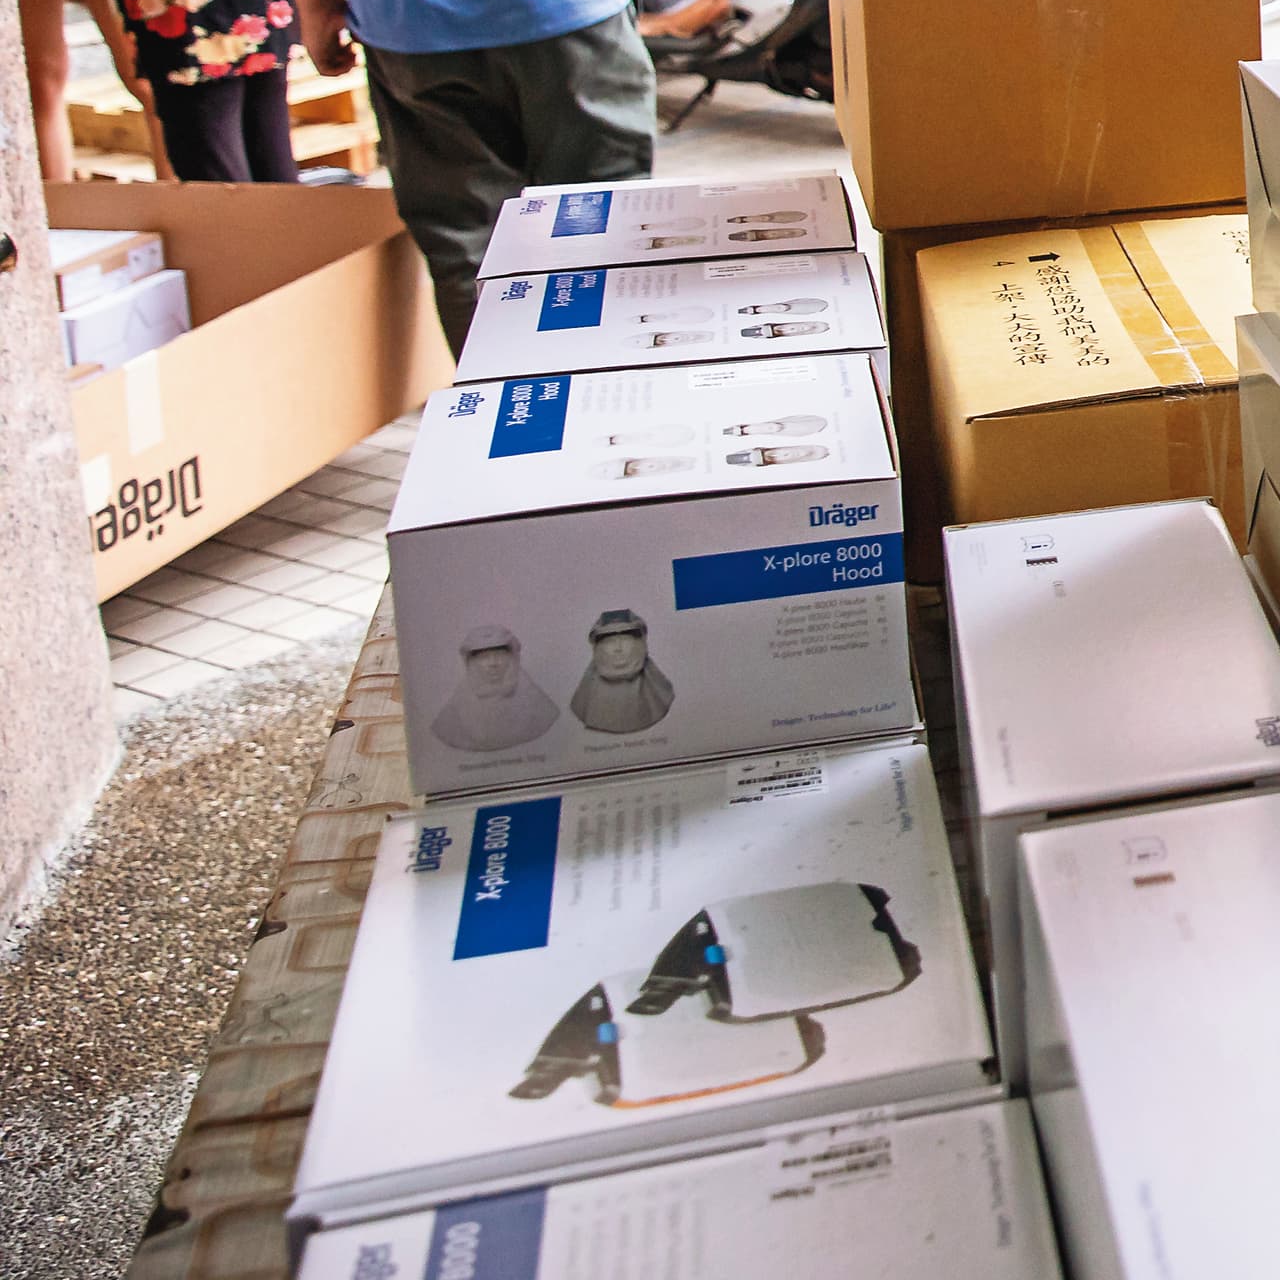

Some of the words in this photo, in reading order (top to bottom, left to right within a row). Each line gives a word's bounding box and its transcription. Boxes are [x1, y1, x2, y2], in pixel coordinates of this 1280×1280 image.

[501, 280, 533, 302] Dräger
[555, 276, 574, 289] 8000
[578, 273, 598, 289] Hood
[511, 384, 534, 402] 8000
[538, 381, 561, 401] Hood
[448, 391, 485, 418] Dräger
[505, 401, 533, 427] X-plore
[809, 504, 880, 527] Dräger
[763, 549, 831, 573] X-plore
[836, 542, 882, 562] 8000
[832, 561, 883, 582] Hood
[483, 815, 511, 851] 8000
[404, 826, 452, 873] Dräger
[475, 852, 510, 902] X-plore
